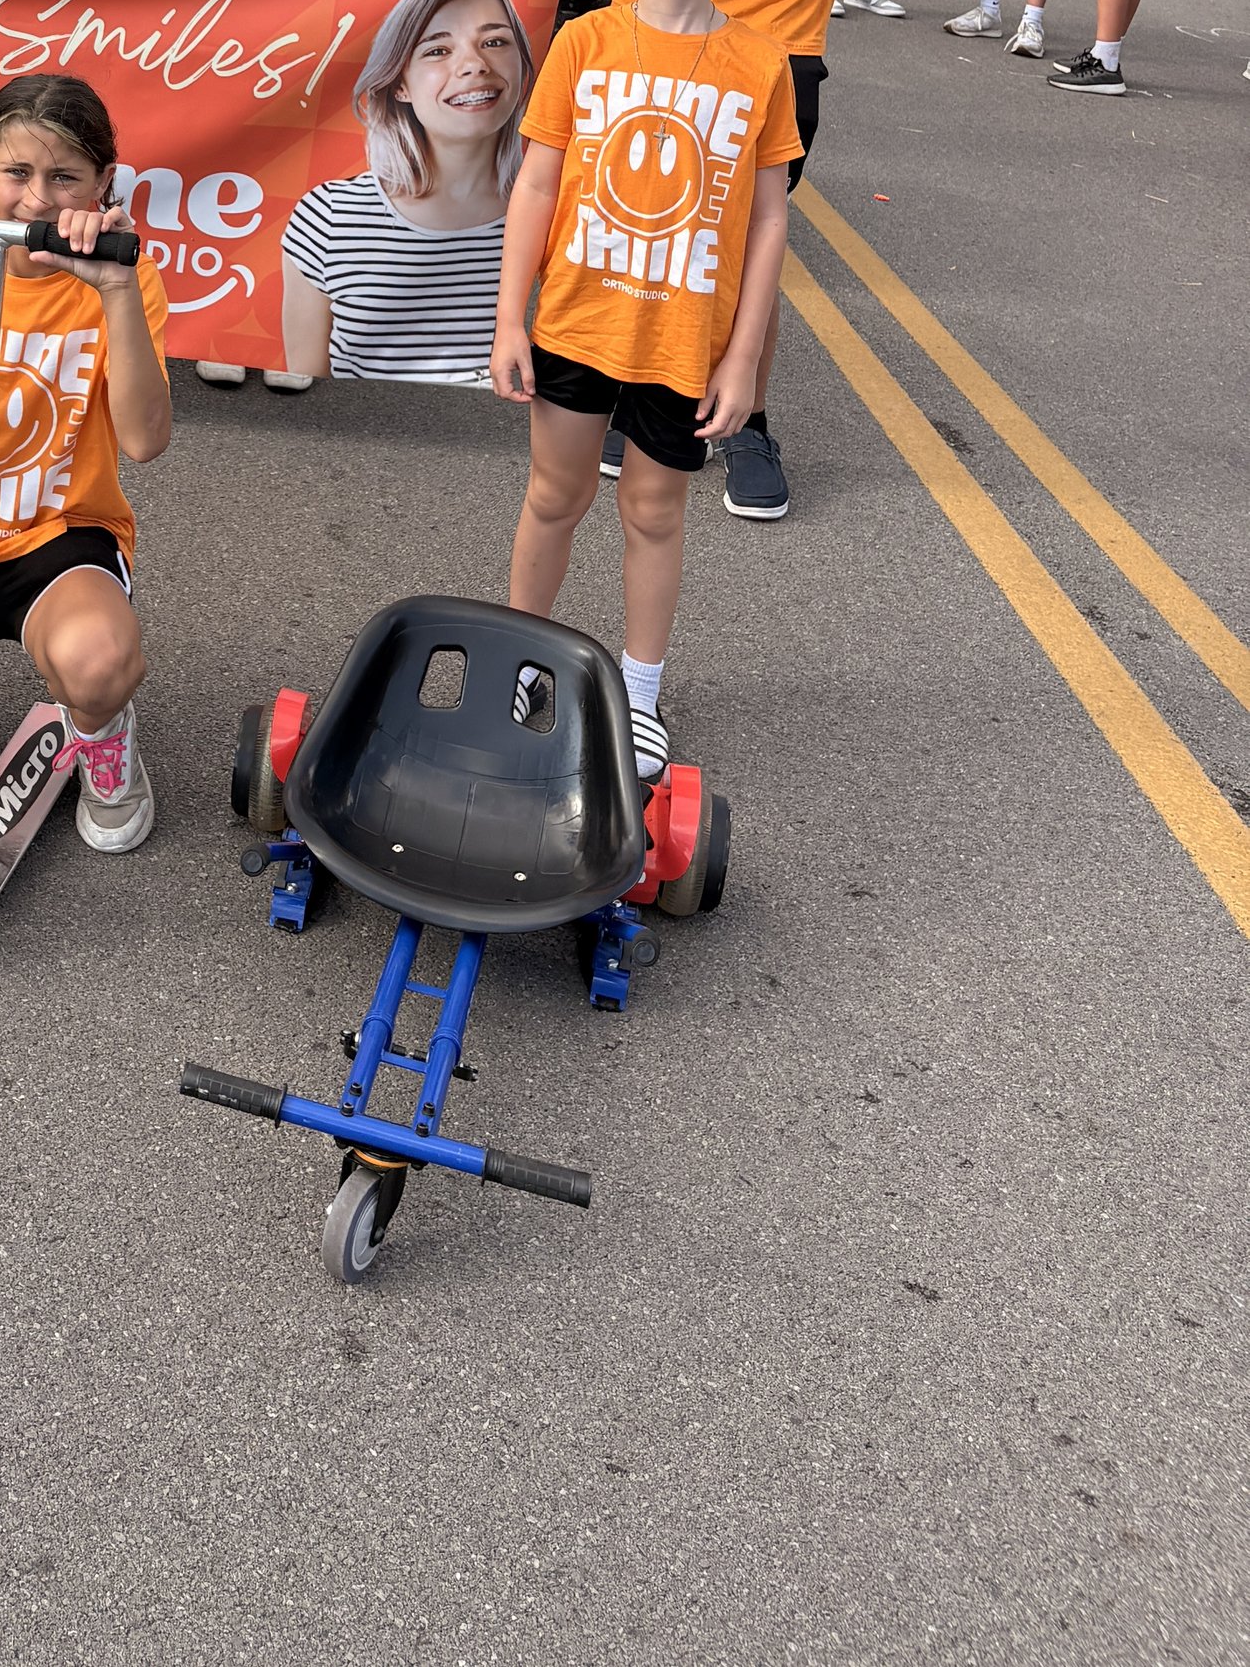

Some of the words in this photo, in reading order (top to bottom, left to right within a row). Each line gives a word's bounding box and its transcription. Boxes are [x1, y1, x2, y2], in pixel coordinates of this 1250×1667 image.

[575, 70, 754, 160] SHINE
[601, 277, 634, 296] ORTHO
[633, 287, 670, 302] STUDIO
